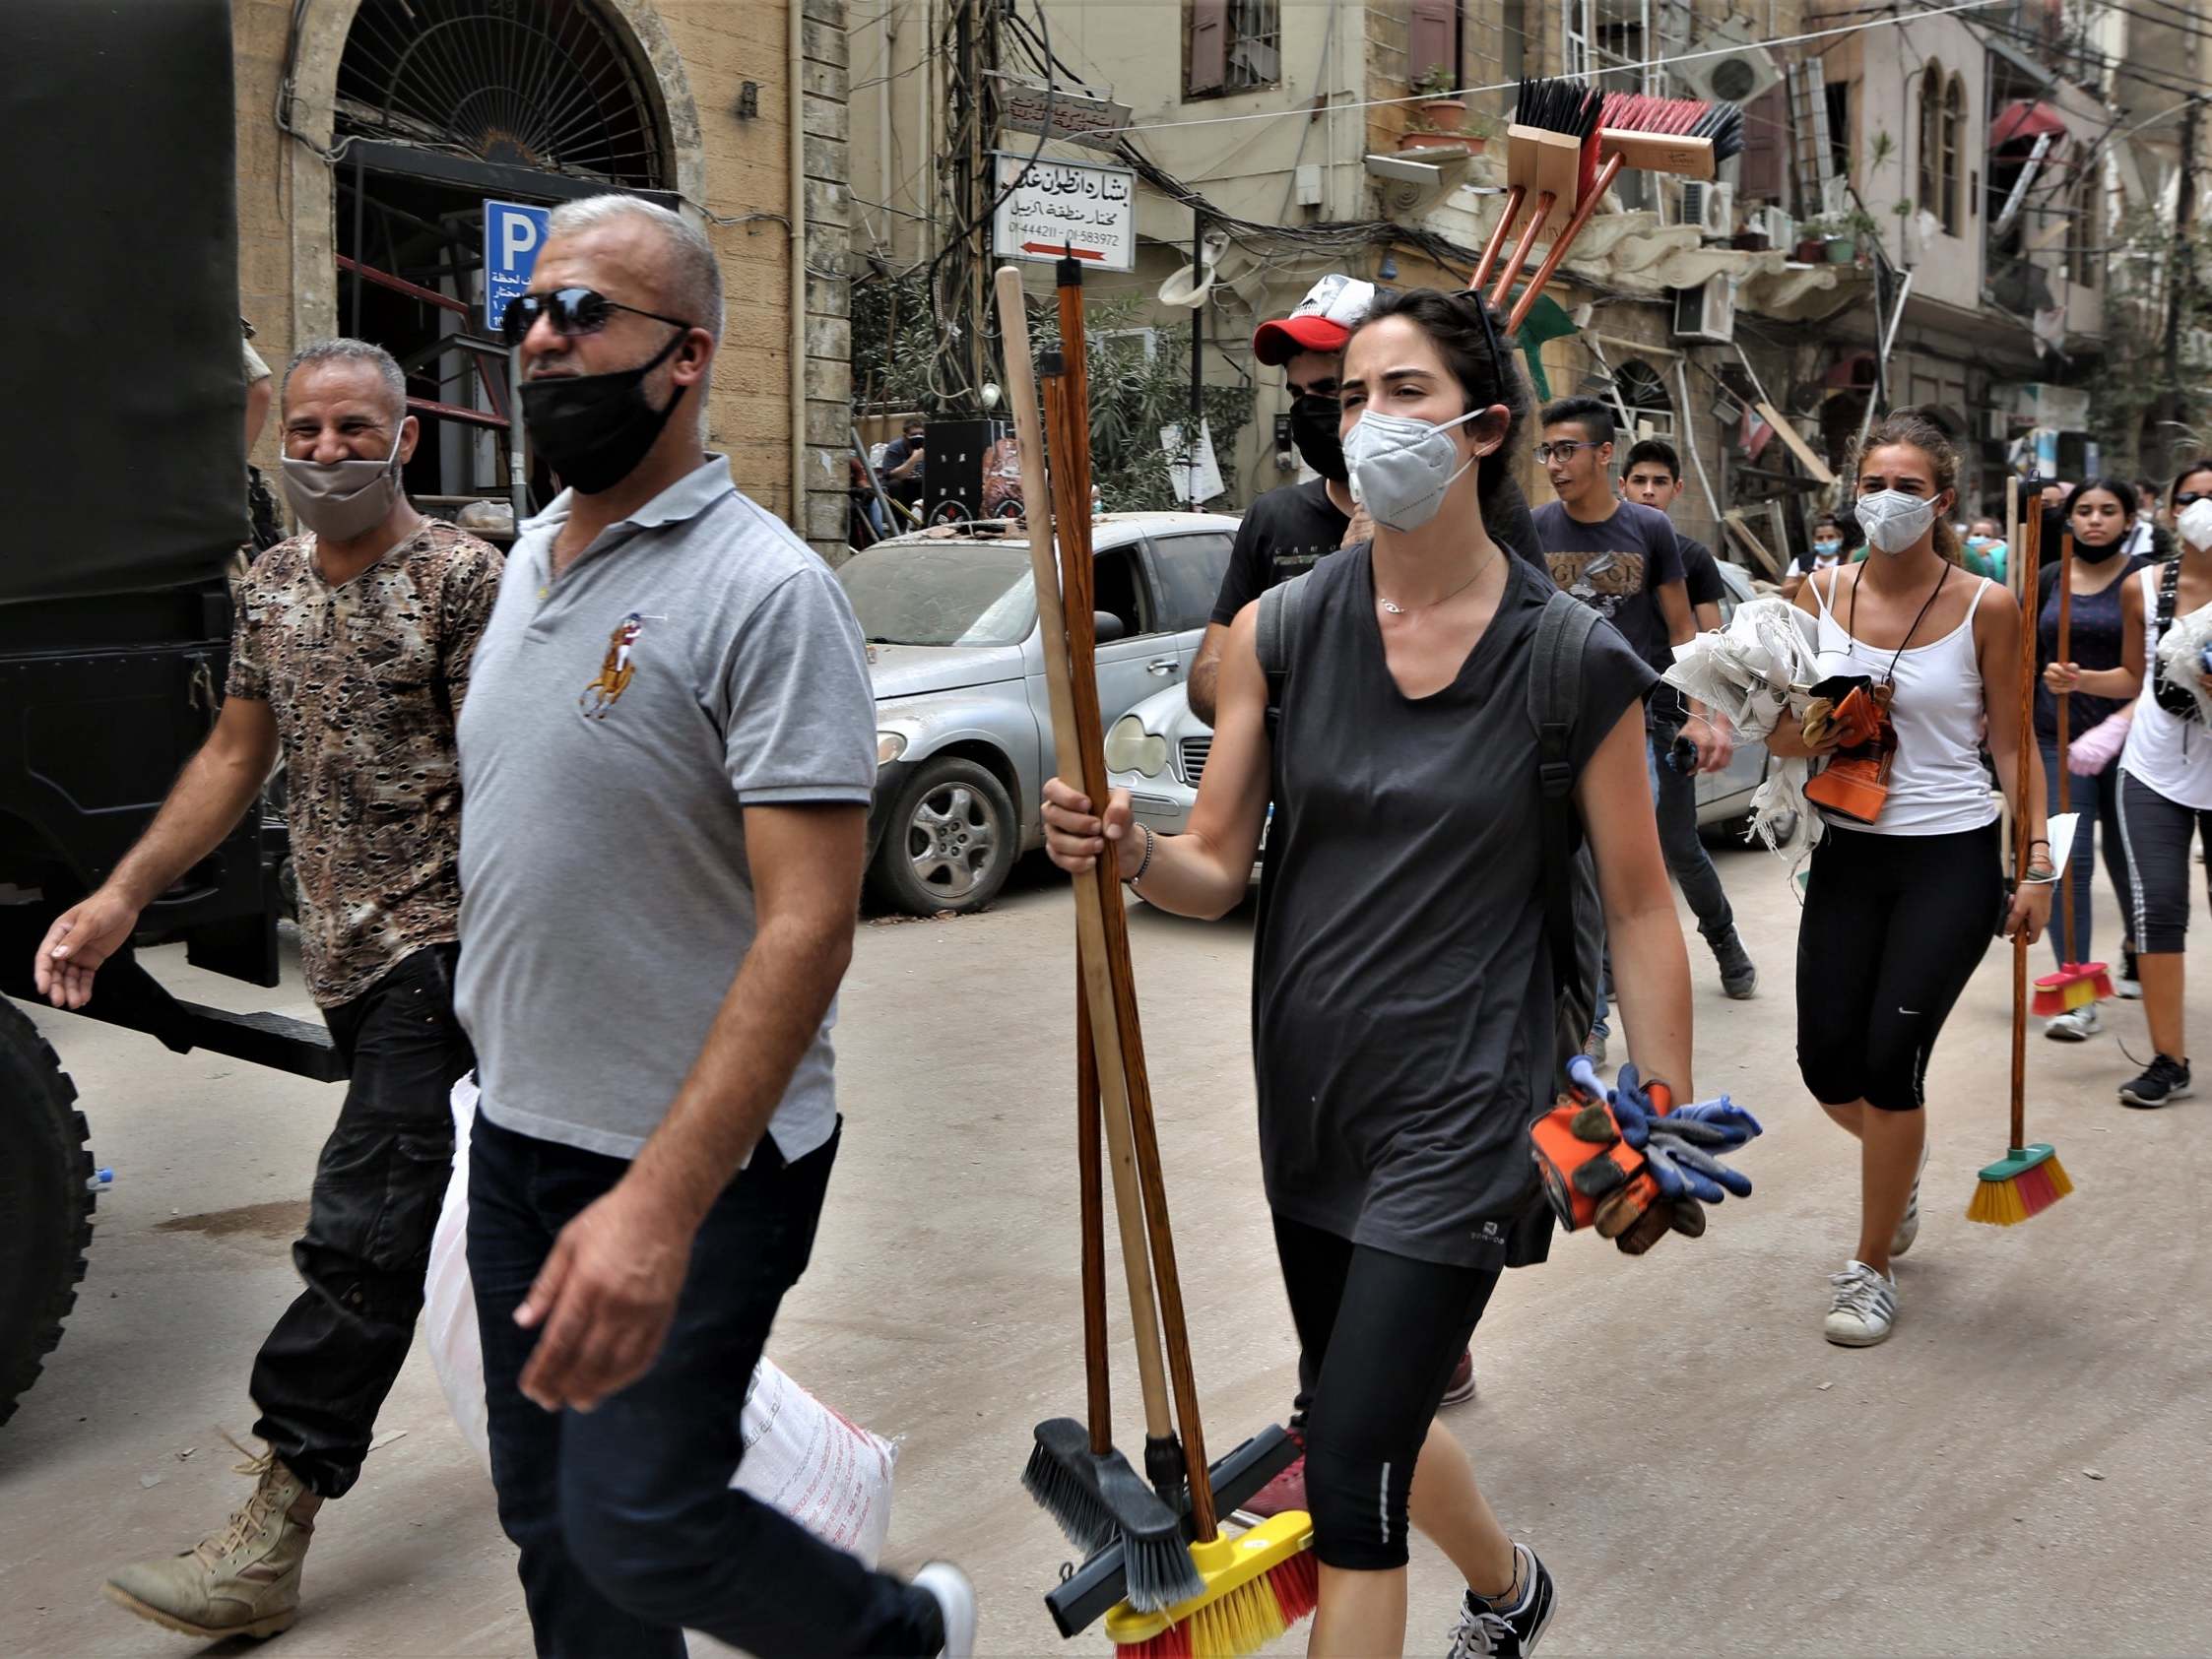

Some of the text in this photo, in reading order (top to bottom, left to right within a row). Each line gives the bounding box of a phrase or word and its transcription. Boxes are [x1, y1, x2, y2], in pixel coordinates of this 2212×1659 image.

[1046, 203, 1085, 221] منطقة
[1085, 209, 1118, 225] مختار
[502, 212, 537, 271] P
[1066, 228, 1120, 247] 01-583972
